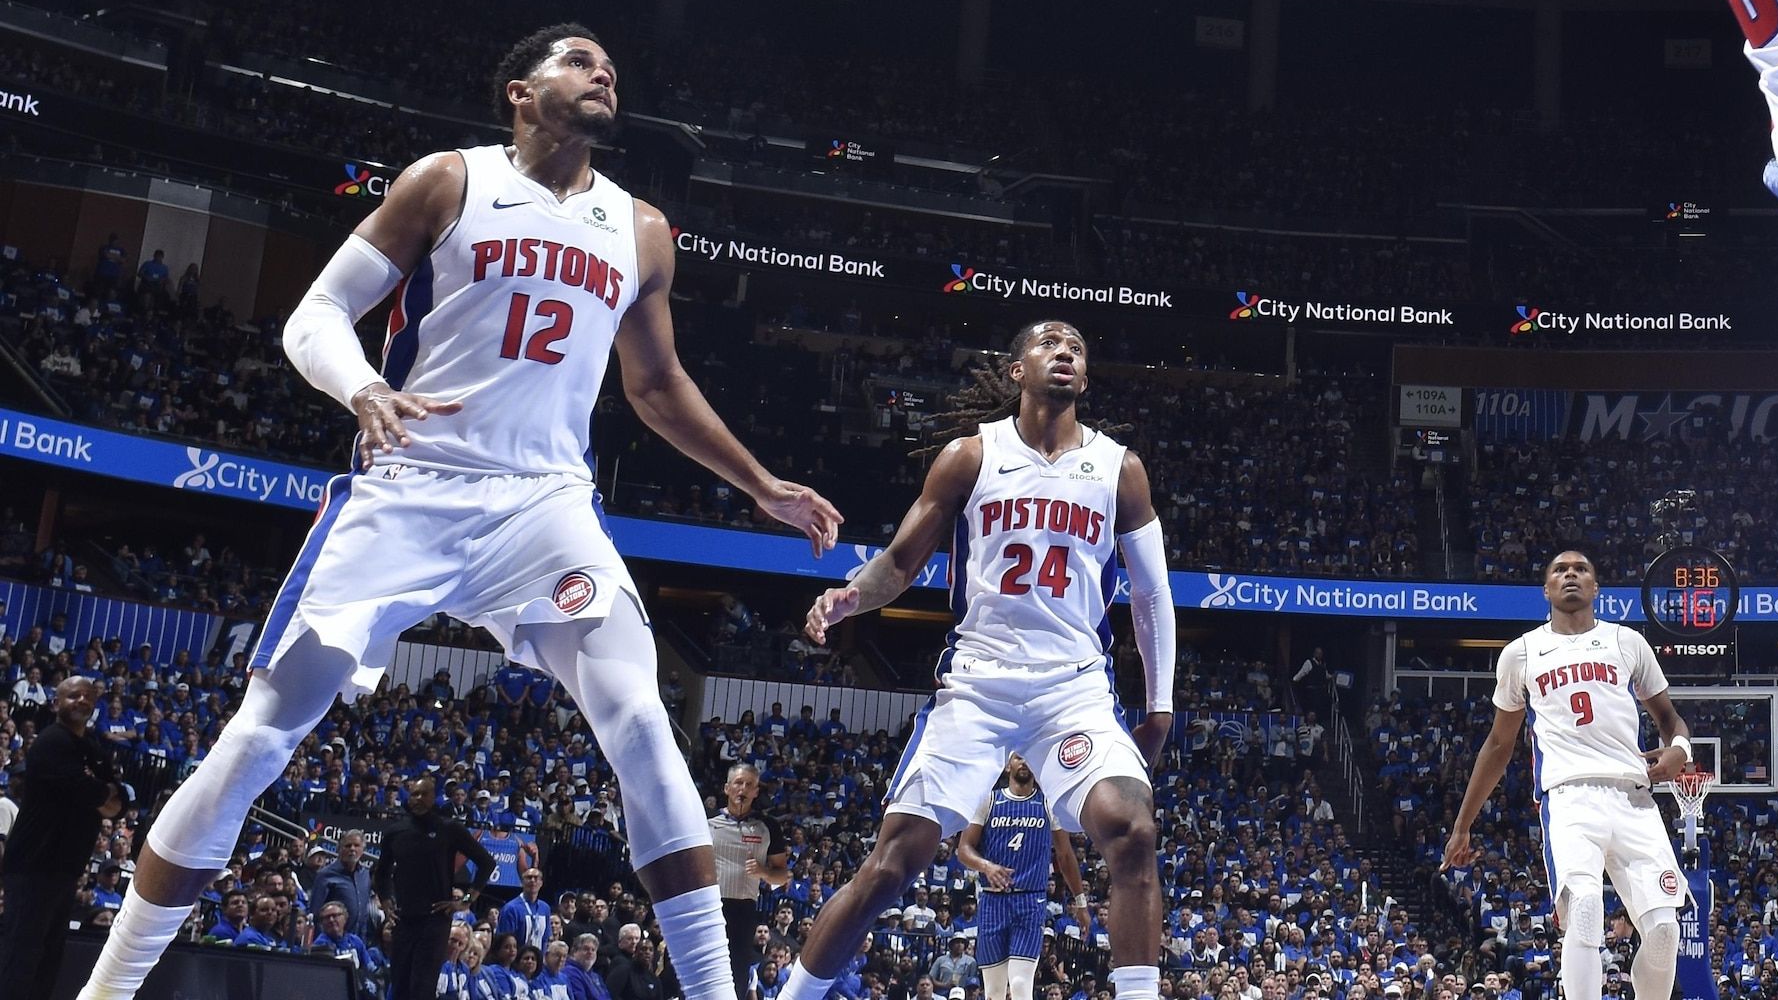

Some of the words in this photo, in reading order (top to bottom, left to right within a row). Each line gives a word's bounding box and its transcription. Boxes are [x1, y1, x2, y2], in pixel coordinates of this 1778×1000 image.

[0, 91, 39, 116] ank
[678, 233, 722, 260] City
[729, 241, 823, 270] National
[829, 255, 884, 277] Bank
[471, 237, 624, 311] PISTONS
[972, 273, 1015, 298] City
[1022, 279, 1112, 302] National
[1119, 287, 1172, 307] Bank
[1258, 299, 1299, 322] City
[1306, 302, 1394, 321] National
[1401, 307, 1453, 324] Bank
[1538, 312, 1579, 333] City
[1586, 313, 1673, 329] National
[1680, 314, 1731, 329] Bank
[500, 292, 573, 366] 12
[1417, 390, 1446, 400] 109A
[1475, 392, 1531, 417] 110A
[1417, 404, 1446, 414] 110A
[14, 421, 92, 462] Bank
[217, 462, 278, 501] City
[978, 498, 1105, 547] PISTONS
[1000, 543, 1071, 598] 24
[1675, 568, 1719, 588] 8:36
[558, 582, 585, 601] DETROIT
[559, 589, 588, 607] PISTONS
[1236, 582, 1289, 609] City
[1297, 585, 1405, 609] National
[1414, 590, 1477, 611] Bank
[1600, 594, 1633, 619] ity
[1682, 590, 1715, 627] 16
[1674, 645, 1727, 655] TISSOT
[1535, 662, 1618, 697] PISTONS
[1570, 691, 1594, 727] 9
[1007, 832, 1024, 851] 4
